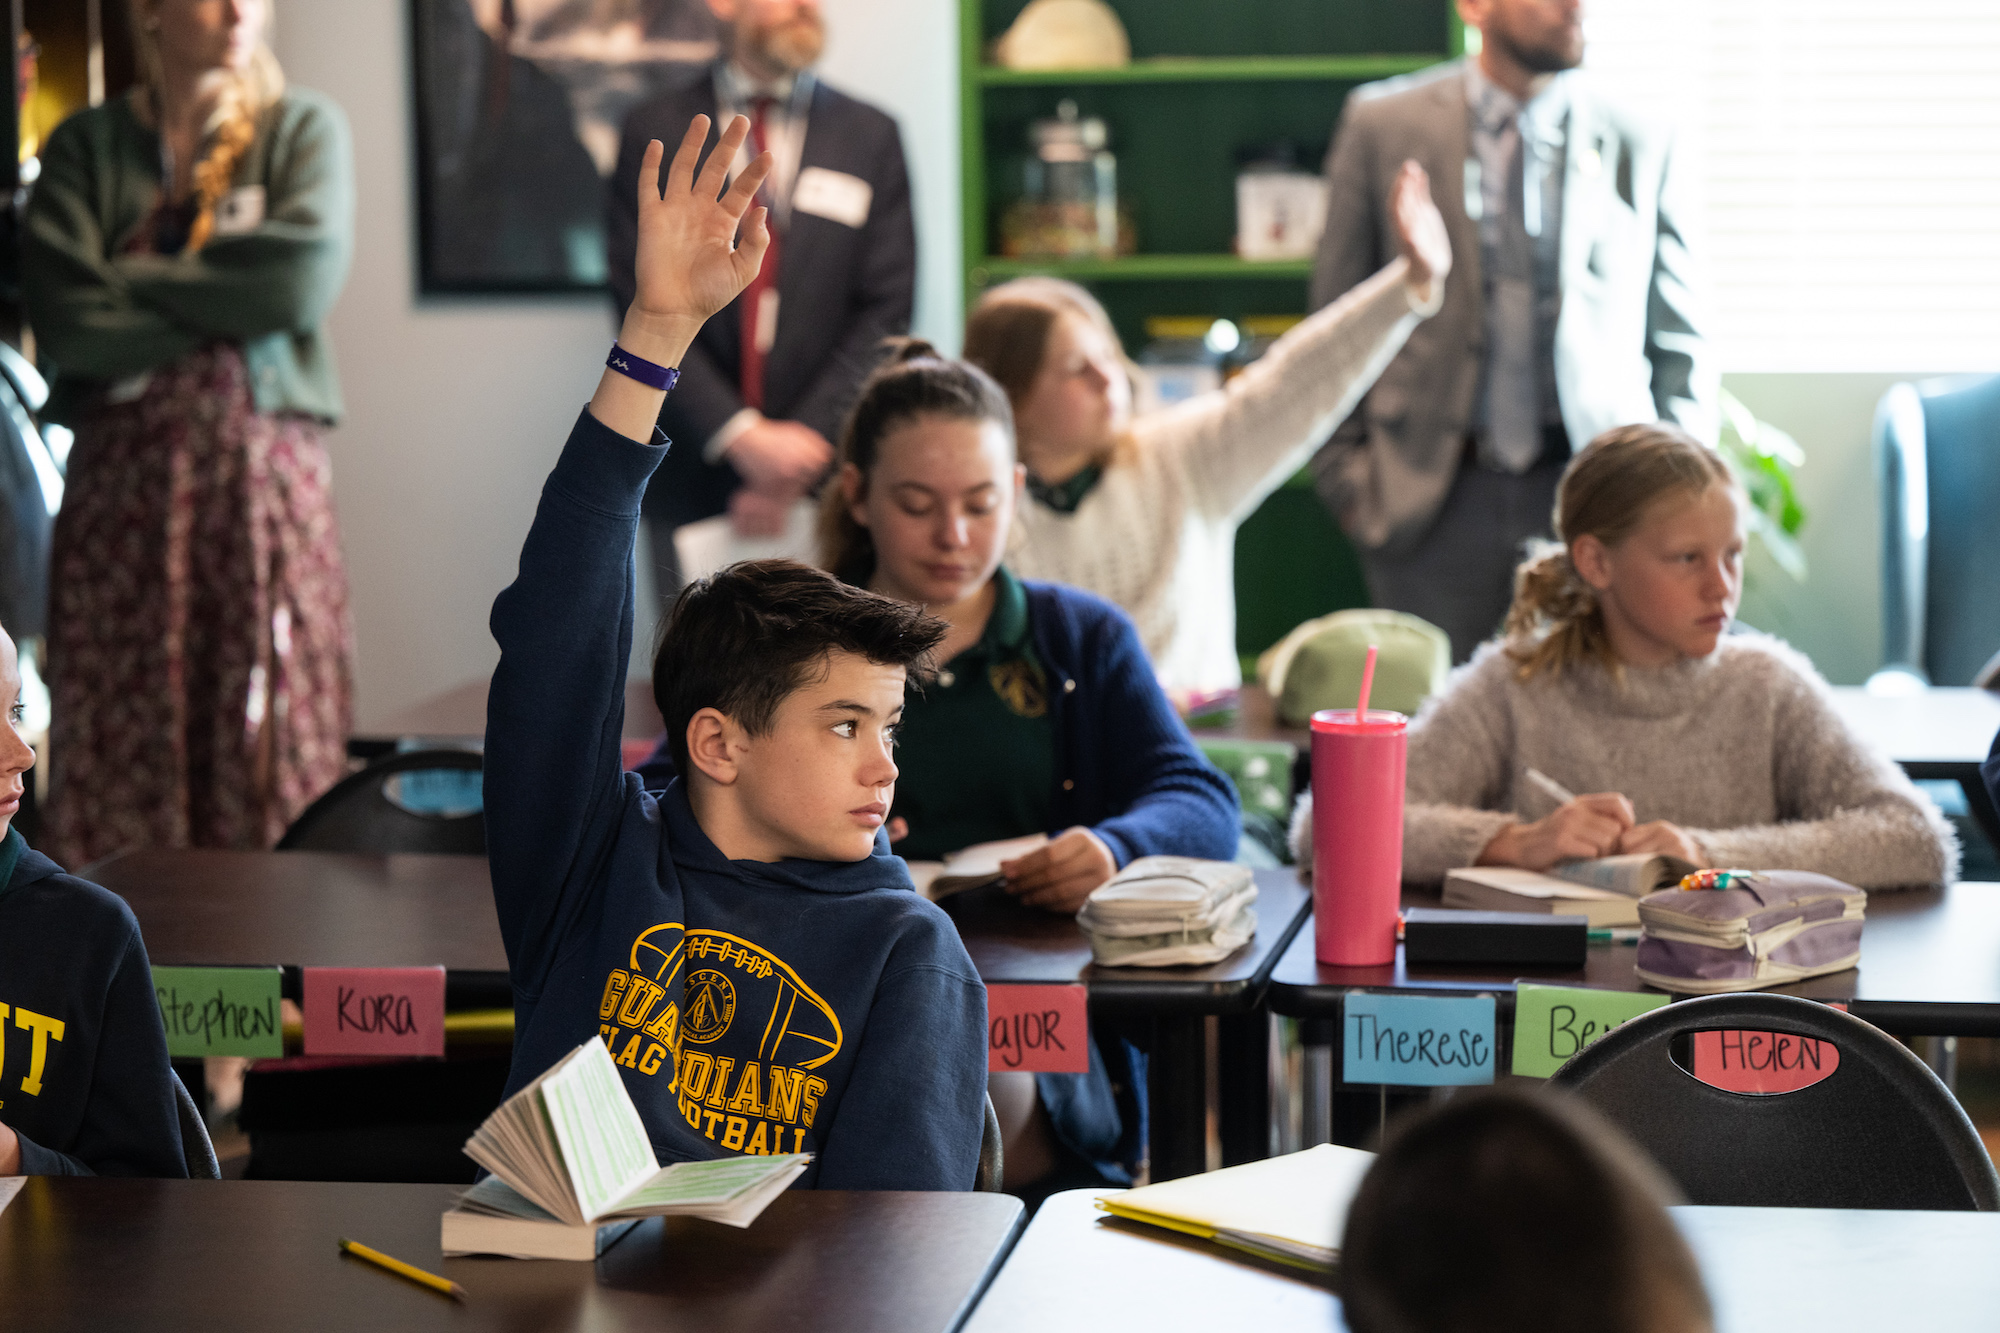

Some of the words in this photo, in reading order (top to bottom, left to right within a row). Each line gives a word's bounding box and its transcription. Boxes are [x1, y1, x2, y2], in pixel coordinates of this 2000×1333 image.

[684, 972, 733, 1001] SCENT
[1549, 1004, 1626, 1058] Be
[668, 1078, 810, 1163] OTBALL
